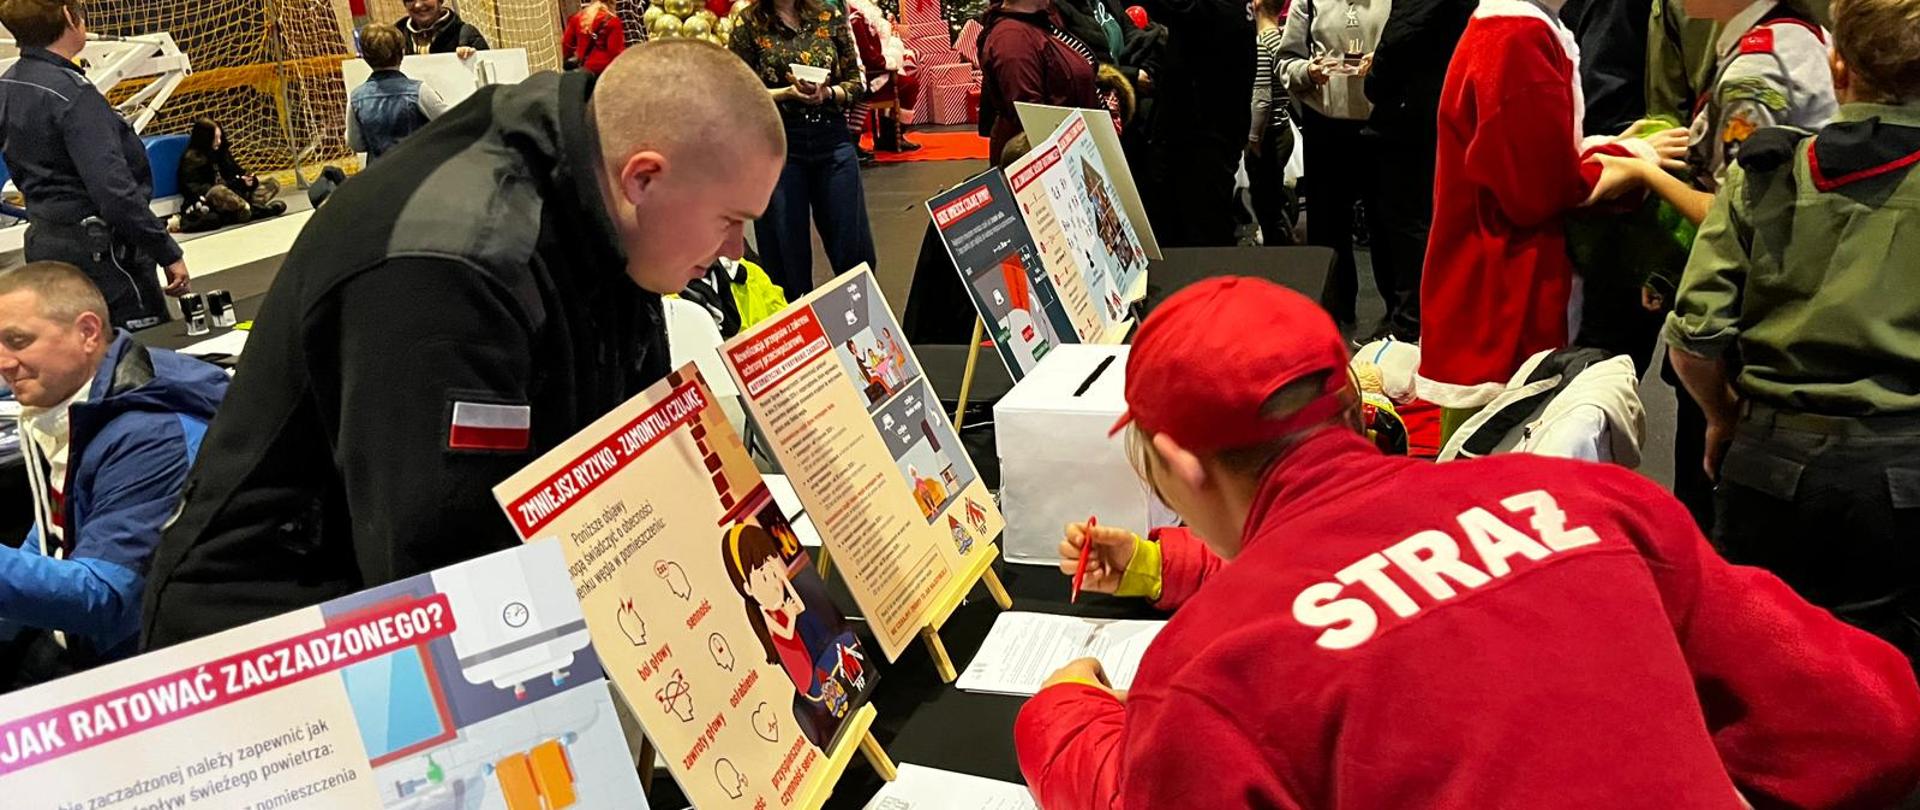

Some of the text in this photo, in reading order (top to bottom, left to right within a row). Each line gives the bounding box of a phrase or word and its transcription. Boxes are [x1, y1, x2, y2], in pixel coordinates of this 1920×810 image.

[518, 473, 580, 528] ZMNIEJSZ
[572, 446, 618, 489] RYZYKO
[617, 411, 671, 457] ZAMONTUJ
[666, 386, 704, 422] CZUJKĘ
[571, 500, 627, 547] Poniższe objawy
[583, 529, 619, 565] świadczyć
[621, 497, 653, 534] obecności
[594, 561, 616, 582] węgla
[1292, 489, 1602, 650] STRAŻ
[686, 598, 712, 630] senność
[1, 602, 444, 764] JAK RATOWAĆ ZACZADZONEGO?
[637, 643, 673, 682] ból głowy
[730, 668, 759, 709] osłabienie
[88, 718, 329, 810] zaczadzonej należy zapewnić jak
[683, 712, 727, 771] zawroty głowy
[801, 748, 818, 773] serca
[190, 769, 258, 802] świeżego
[261, 743, 335, 780] powietrza:
[256, 767, 358, 810] pomieszczenia
